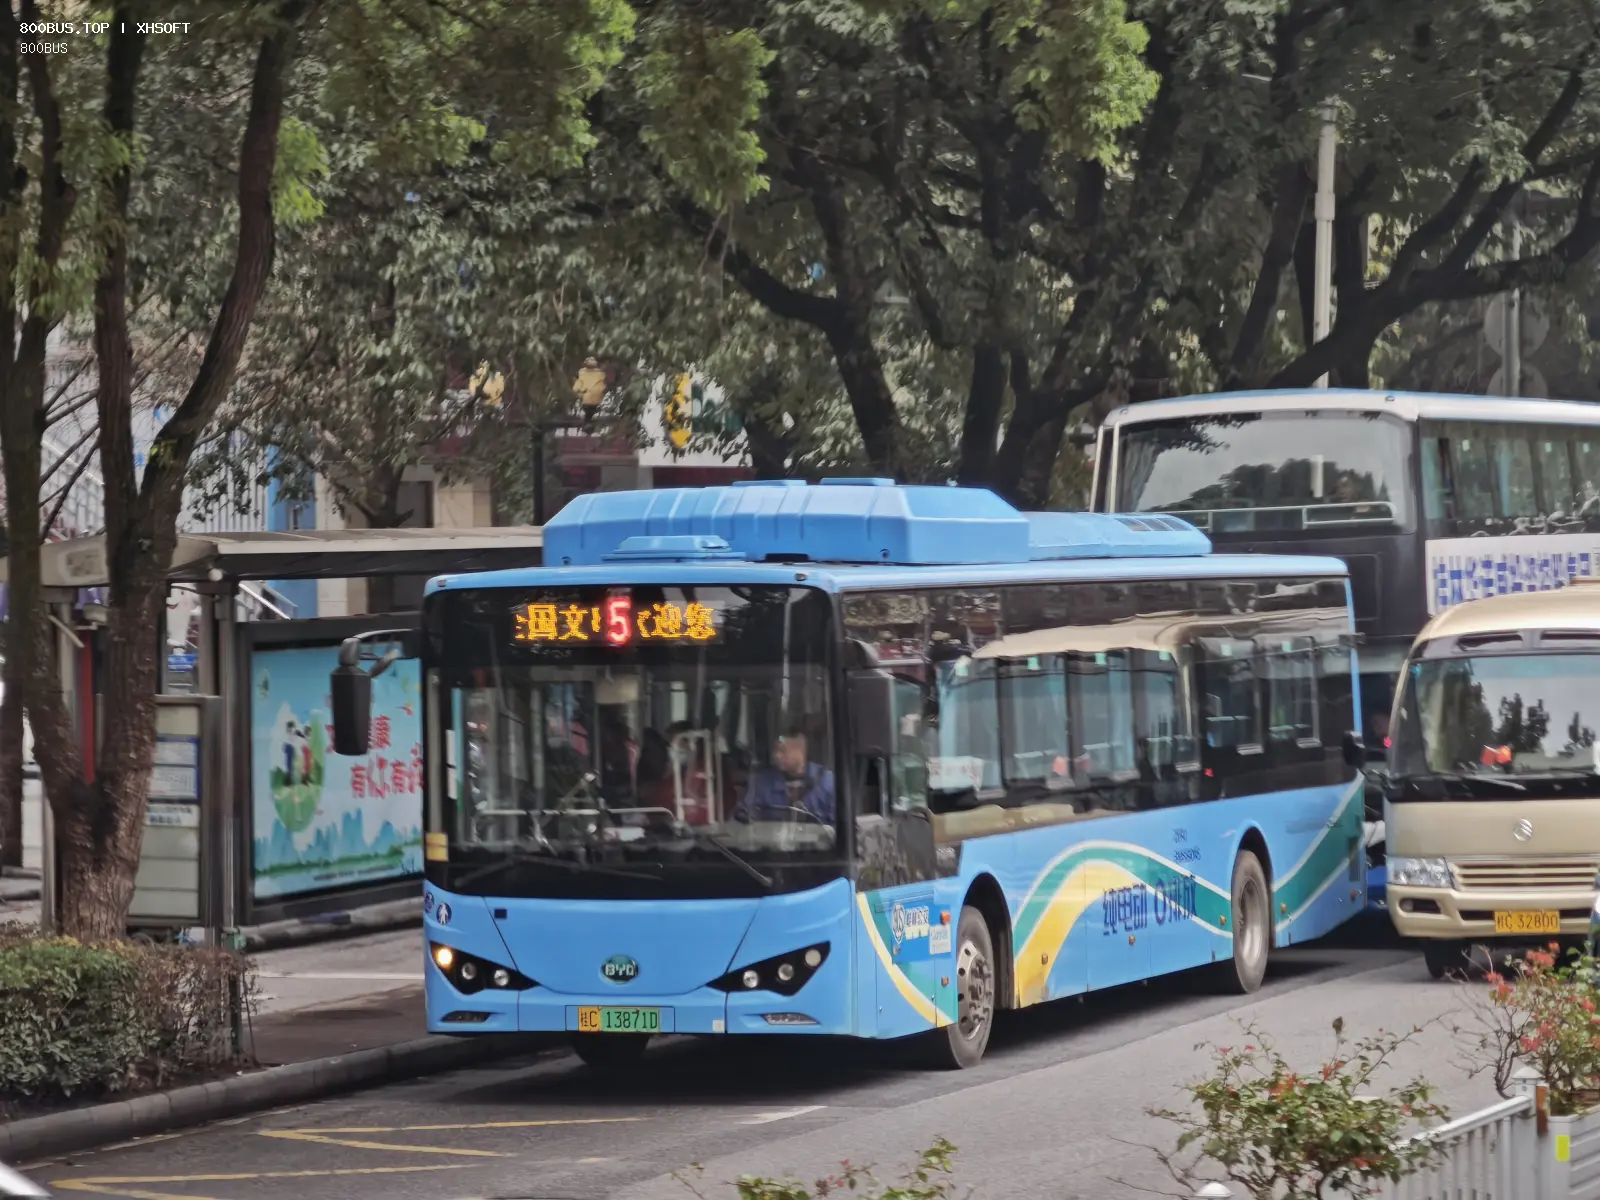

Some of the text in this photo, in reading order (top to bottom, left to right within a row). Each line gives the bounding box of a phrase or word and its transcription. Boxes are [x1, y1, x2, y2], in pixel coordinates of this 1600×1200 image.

[606, 597, 632, 644] 5
[605, 963, 635, 977] BYD
[606, 1010, 658, 1029] 13871D
